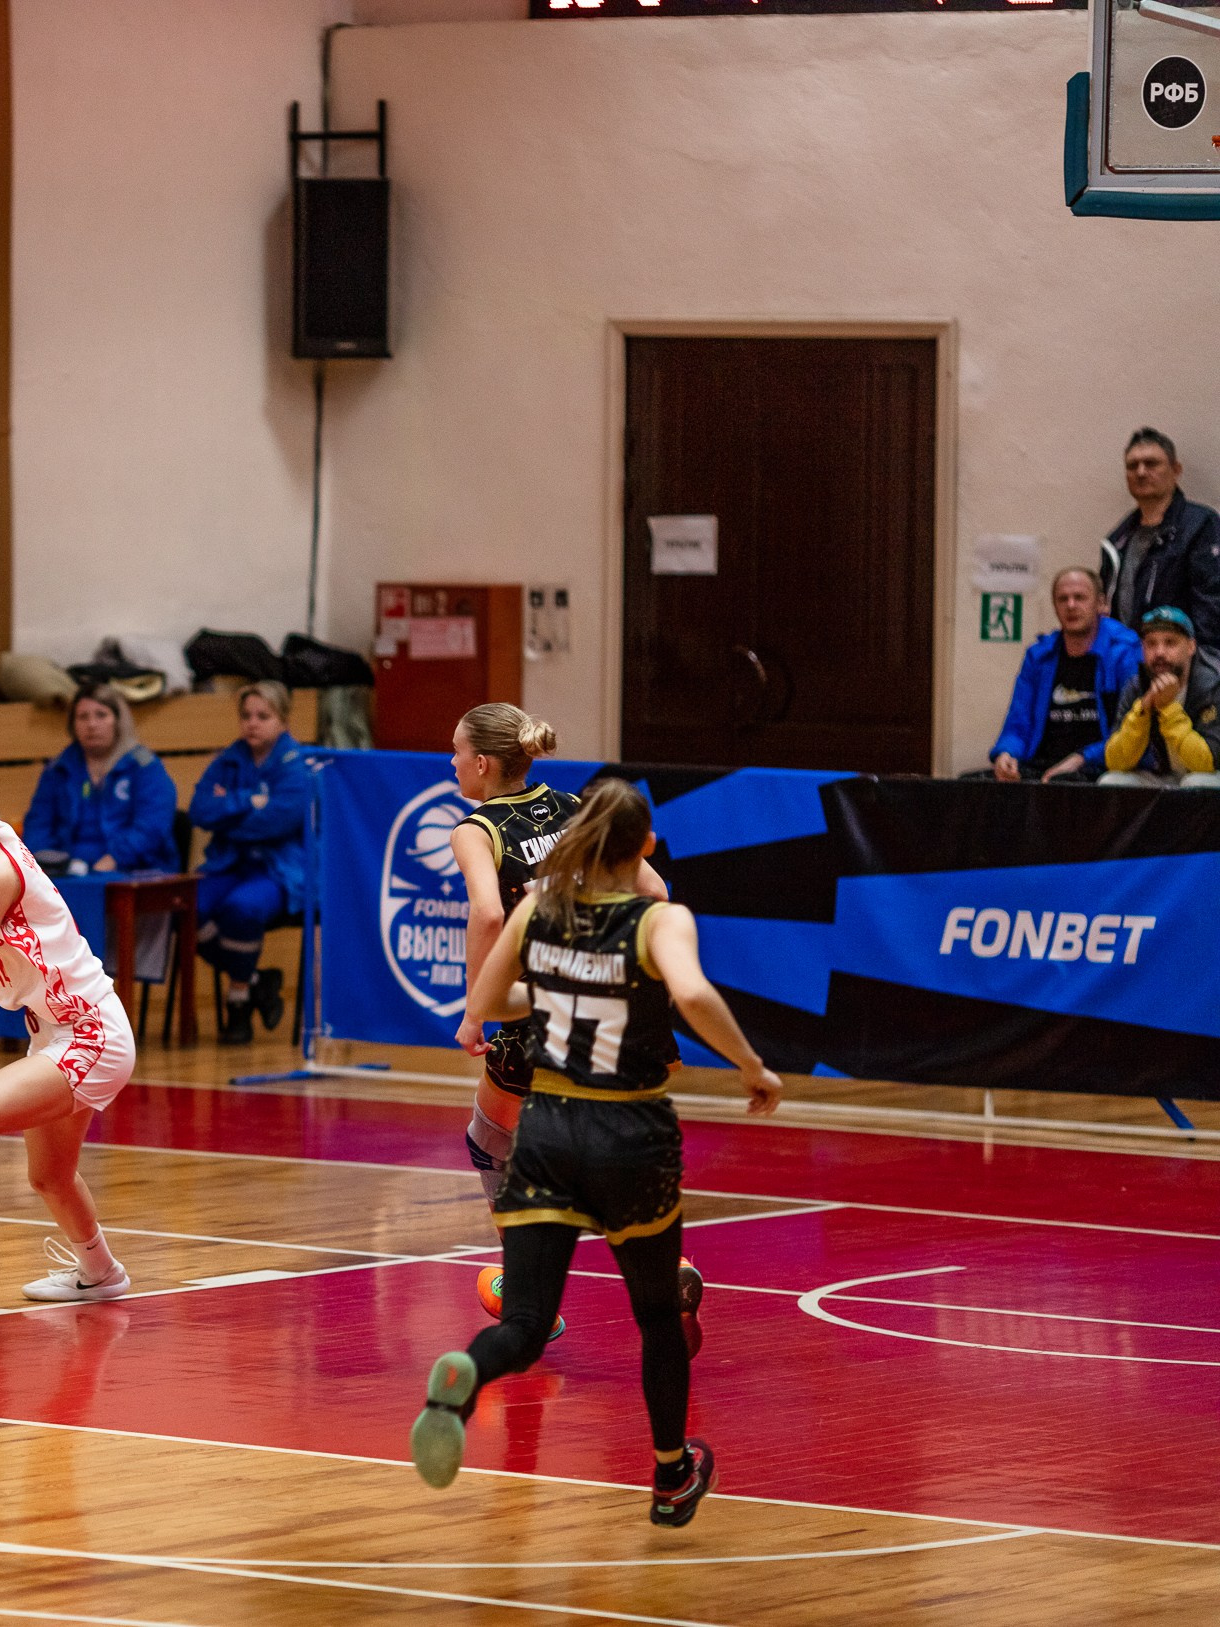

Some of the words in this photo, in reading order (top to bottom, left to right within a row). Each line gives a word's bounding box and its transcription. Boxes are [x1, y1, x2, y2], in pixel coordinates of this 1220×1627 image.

[1150, 82, 1199, 103] РФБ
[413, 898, 469, 920] FONBE
[397, 924, 467, 963] ВЫСШ
[939, 906, 1157, 965] FONBET
[532, 985, 629, 1075] 77
